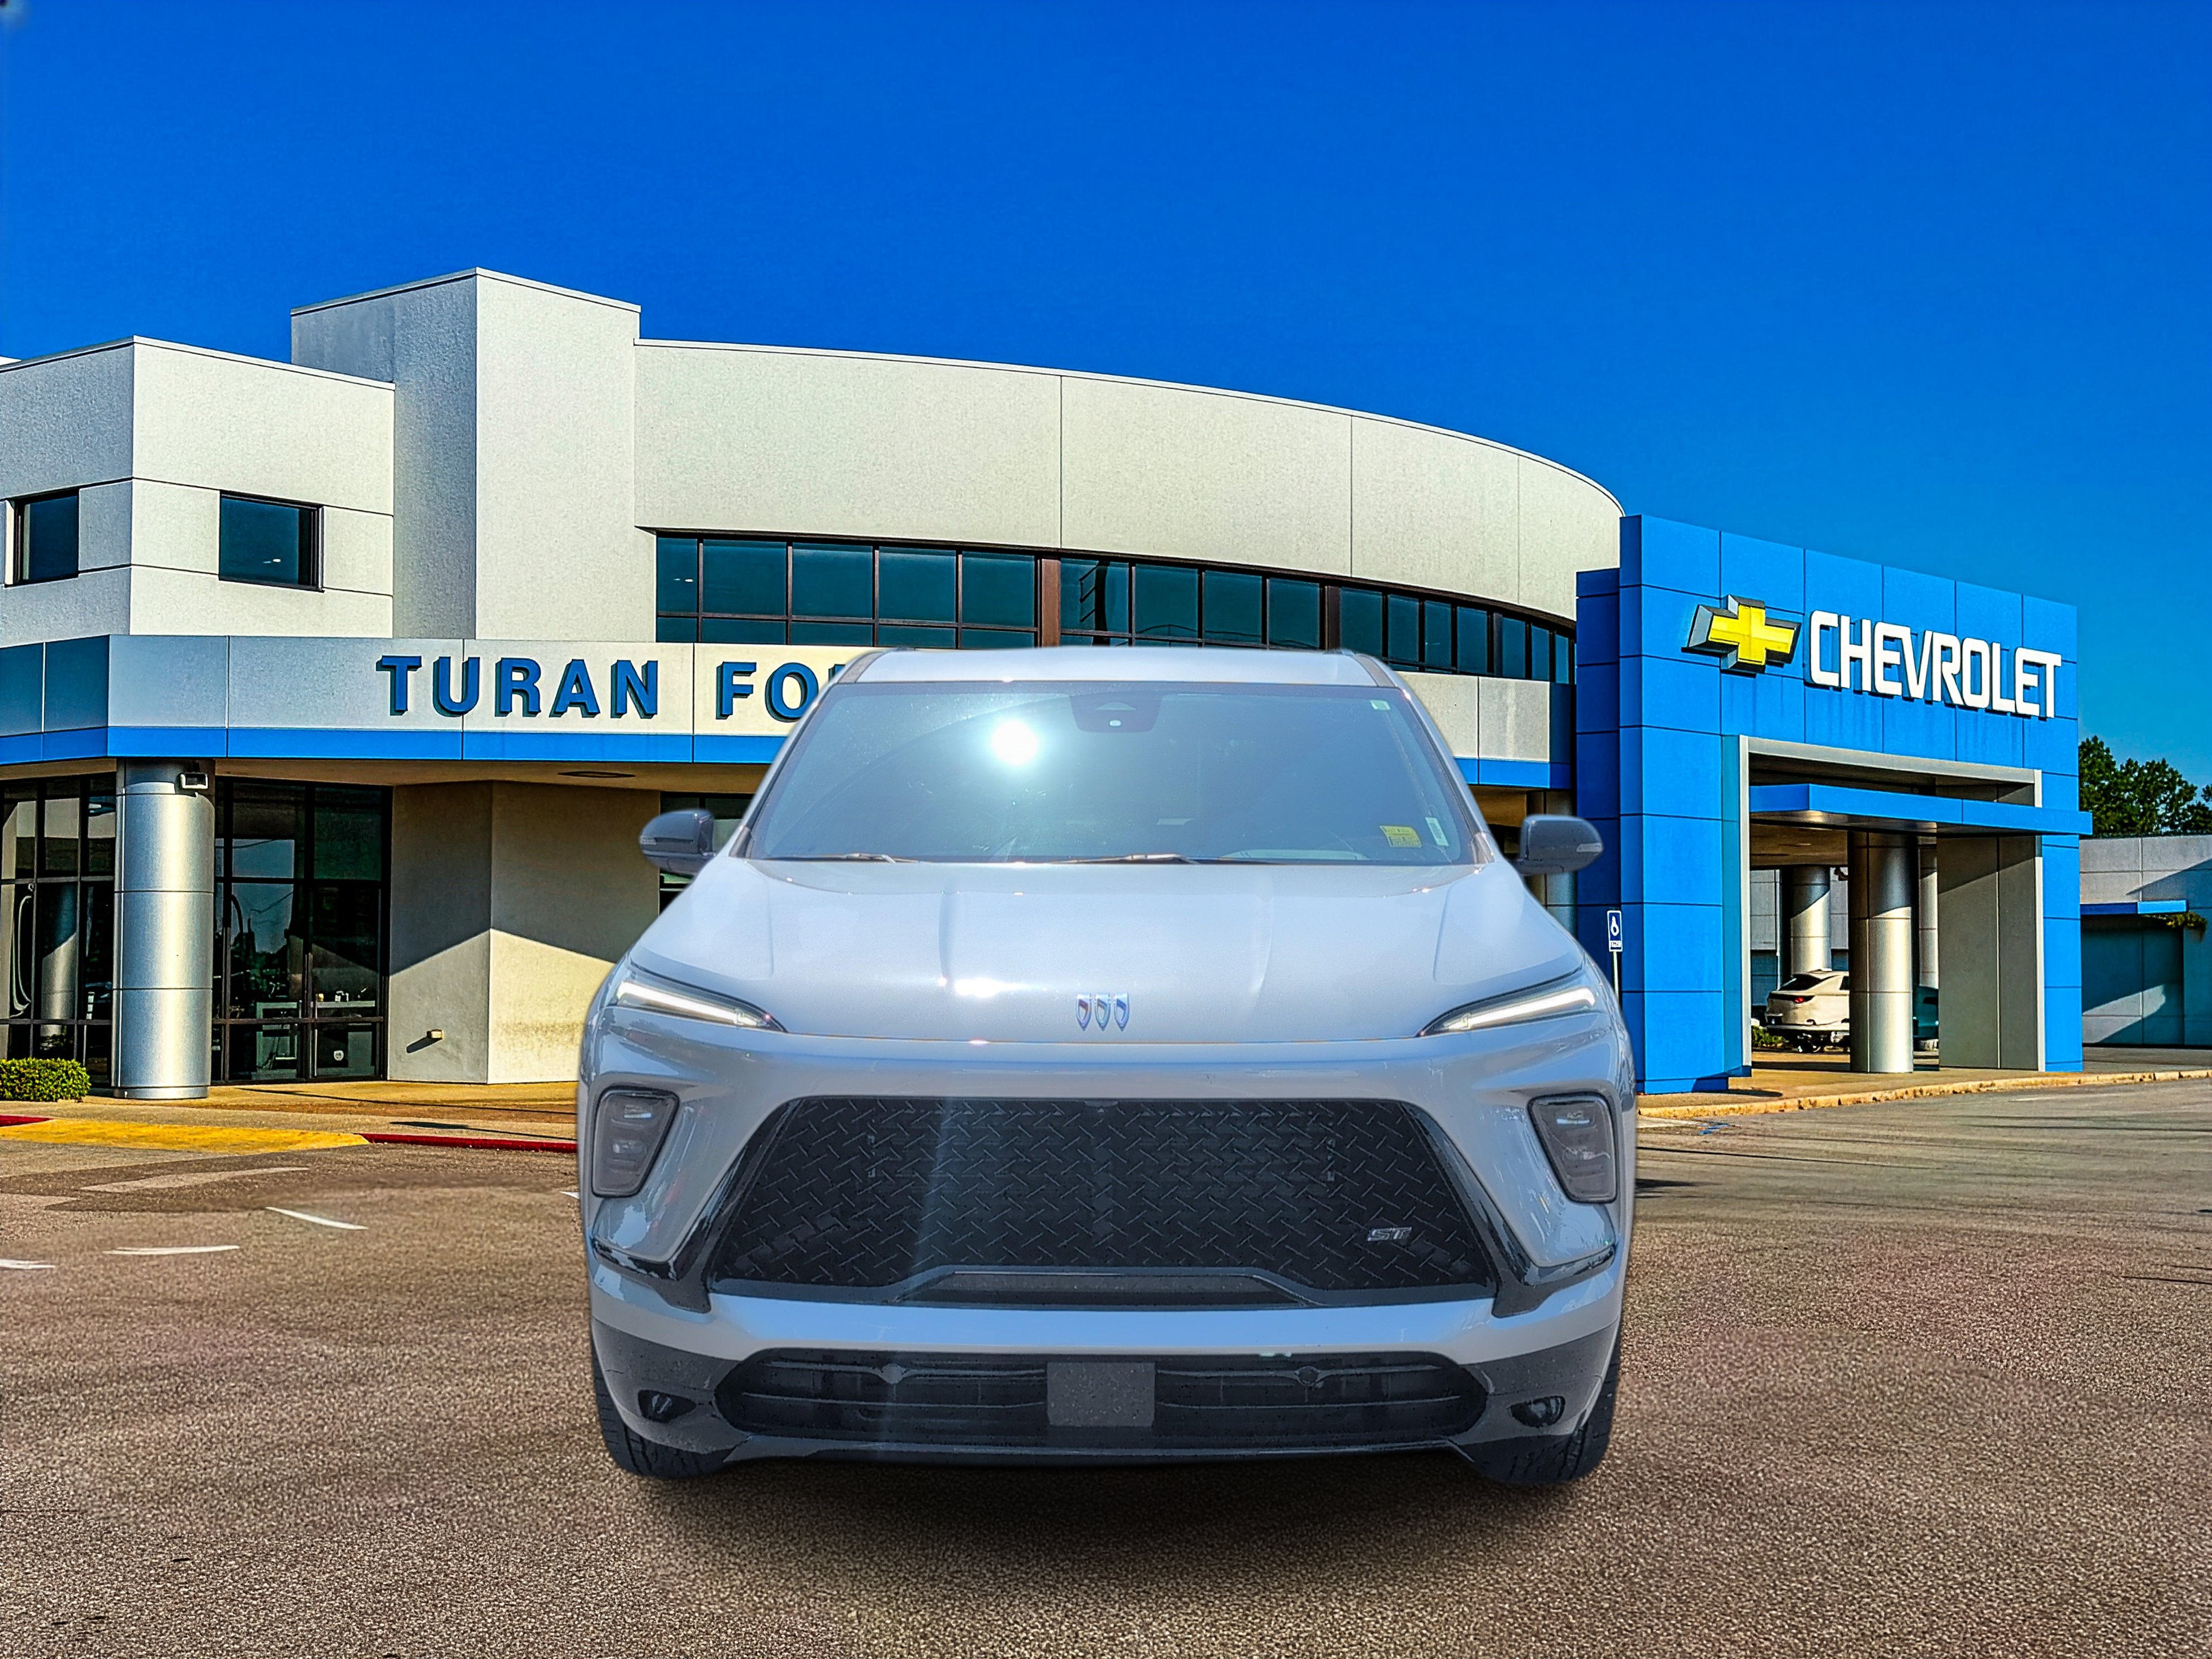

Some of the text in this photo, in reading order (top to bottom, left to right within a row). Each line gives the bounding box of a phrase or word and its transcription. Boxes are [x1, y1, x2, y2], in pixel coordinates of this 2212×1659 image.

[376, 655, 846, 723] TURAN FO
[1809, 610, 2062, 719] CHEVROLET
[1367, 1226, 1412, 1241] ST
